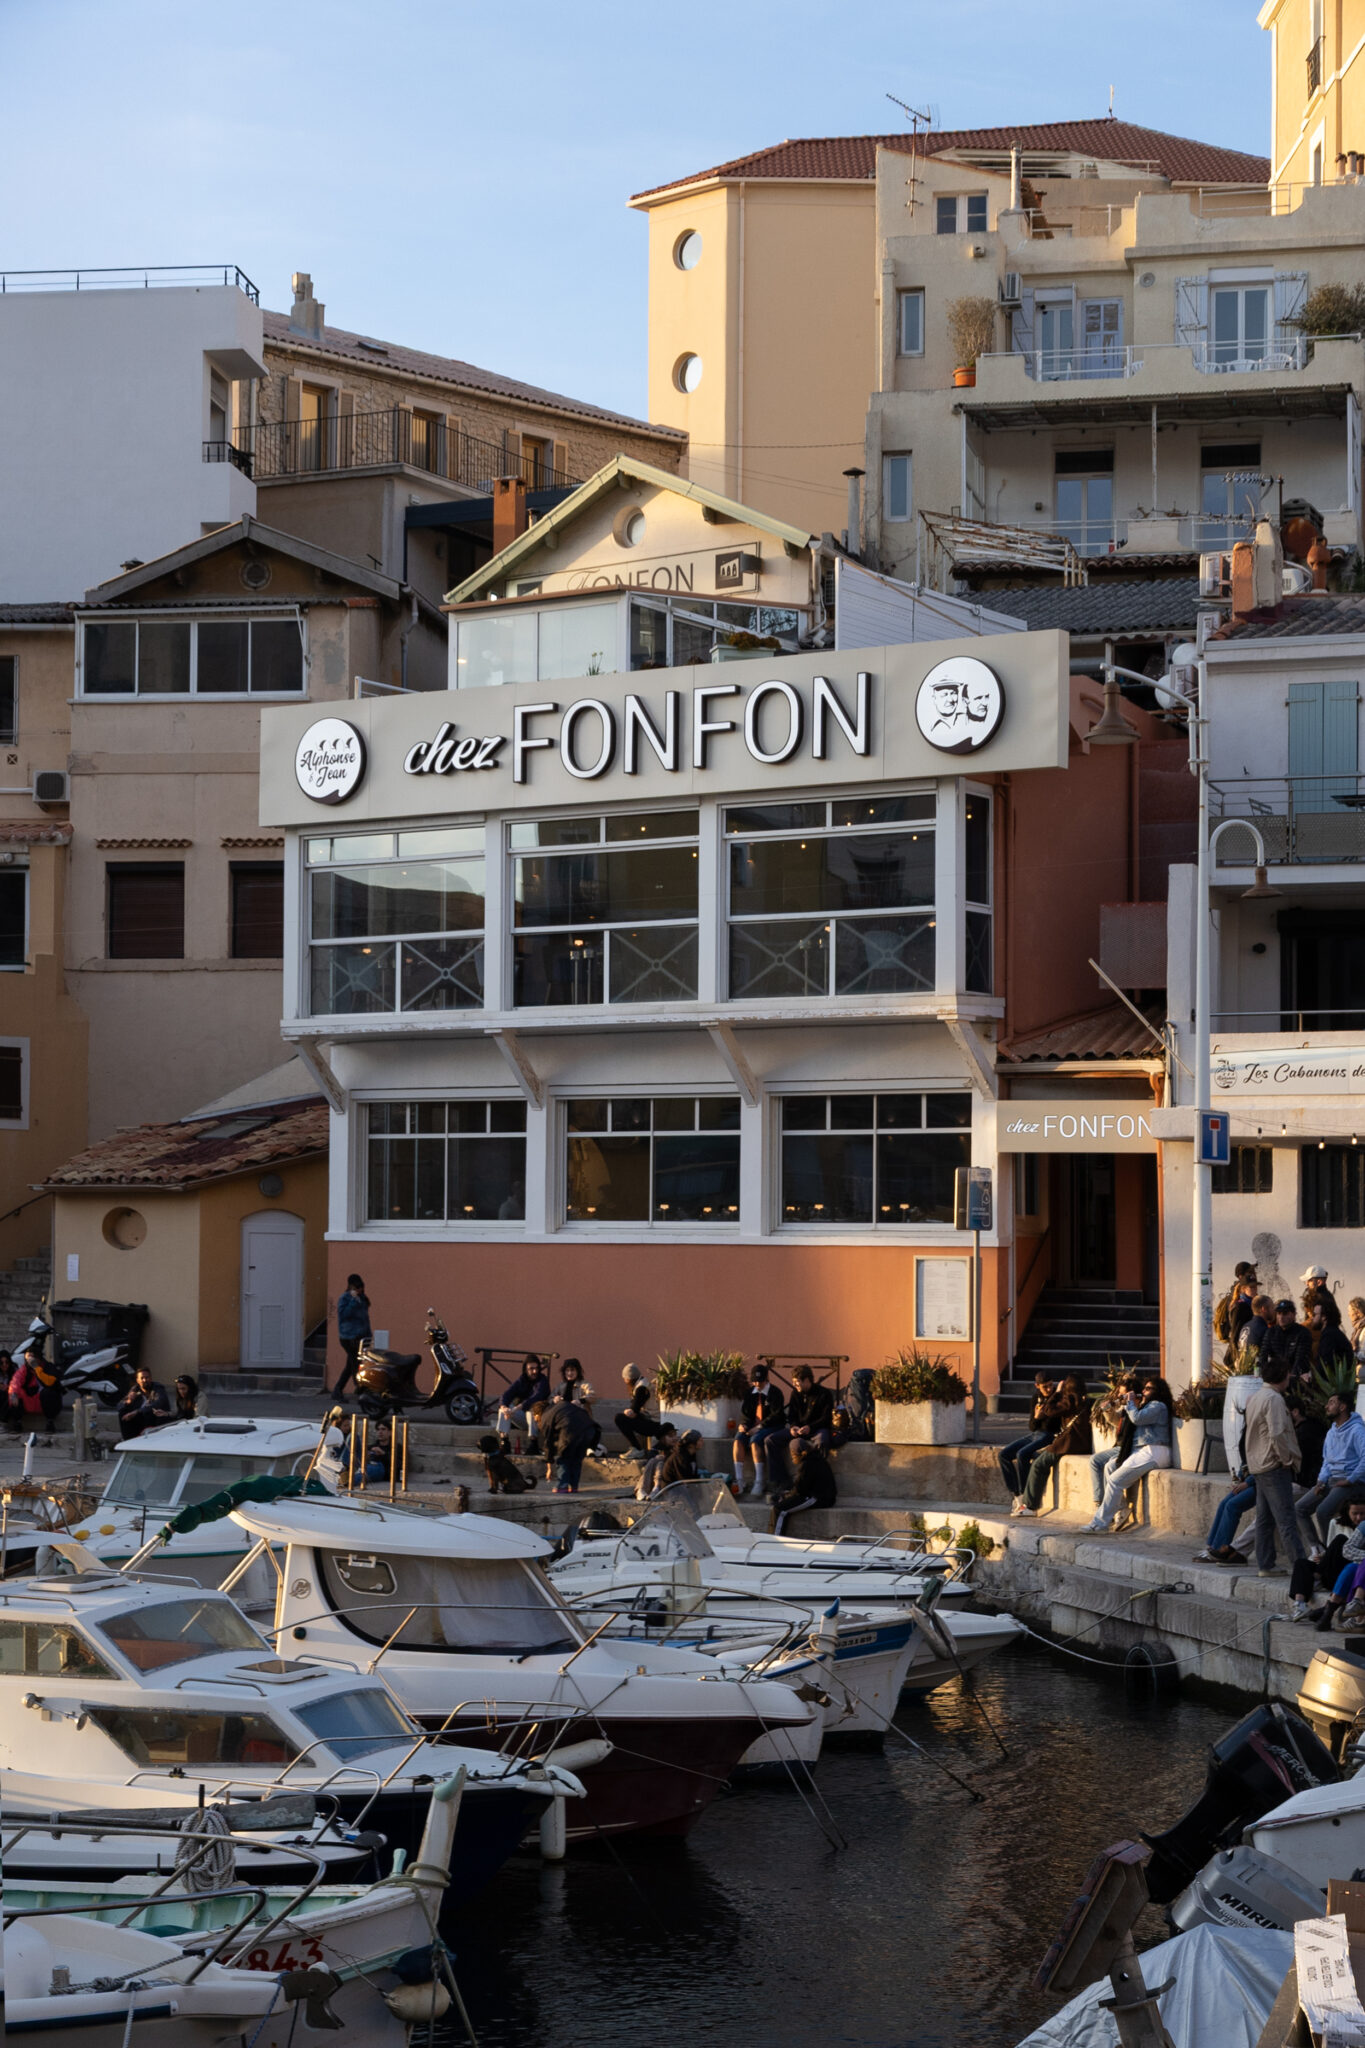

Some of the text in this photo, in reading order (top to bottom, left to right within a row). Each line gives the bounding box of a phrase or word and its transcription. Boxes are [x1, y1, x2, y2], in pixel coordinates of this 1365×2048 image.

[404, 672, 872, 784] chez FONFON
[300, 749, 356, 771] Alphonse
[316, 766, 347, 788] Jean
[1243, 1063, 1269, 1084] Les
[1273, 1063, 1347, 1083] Cabanons
[1006, 1114, 1151, 1138] chez FONFON
